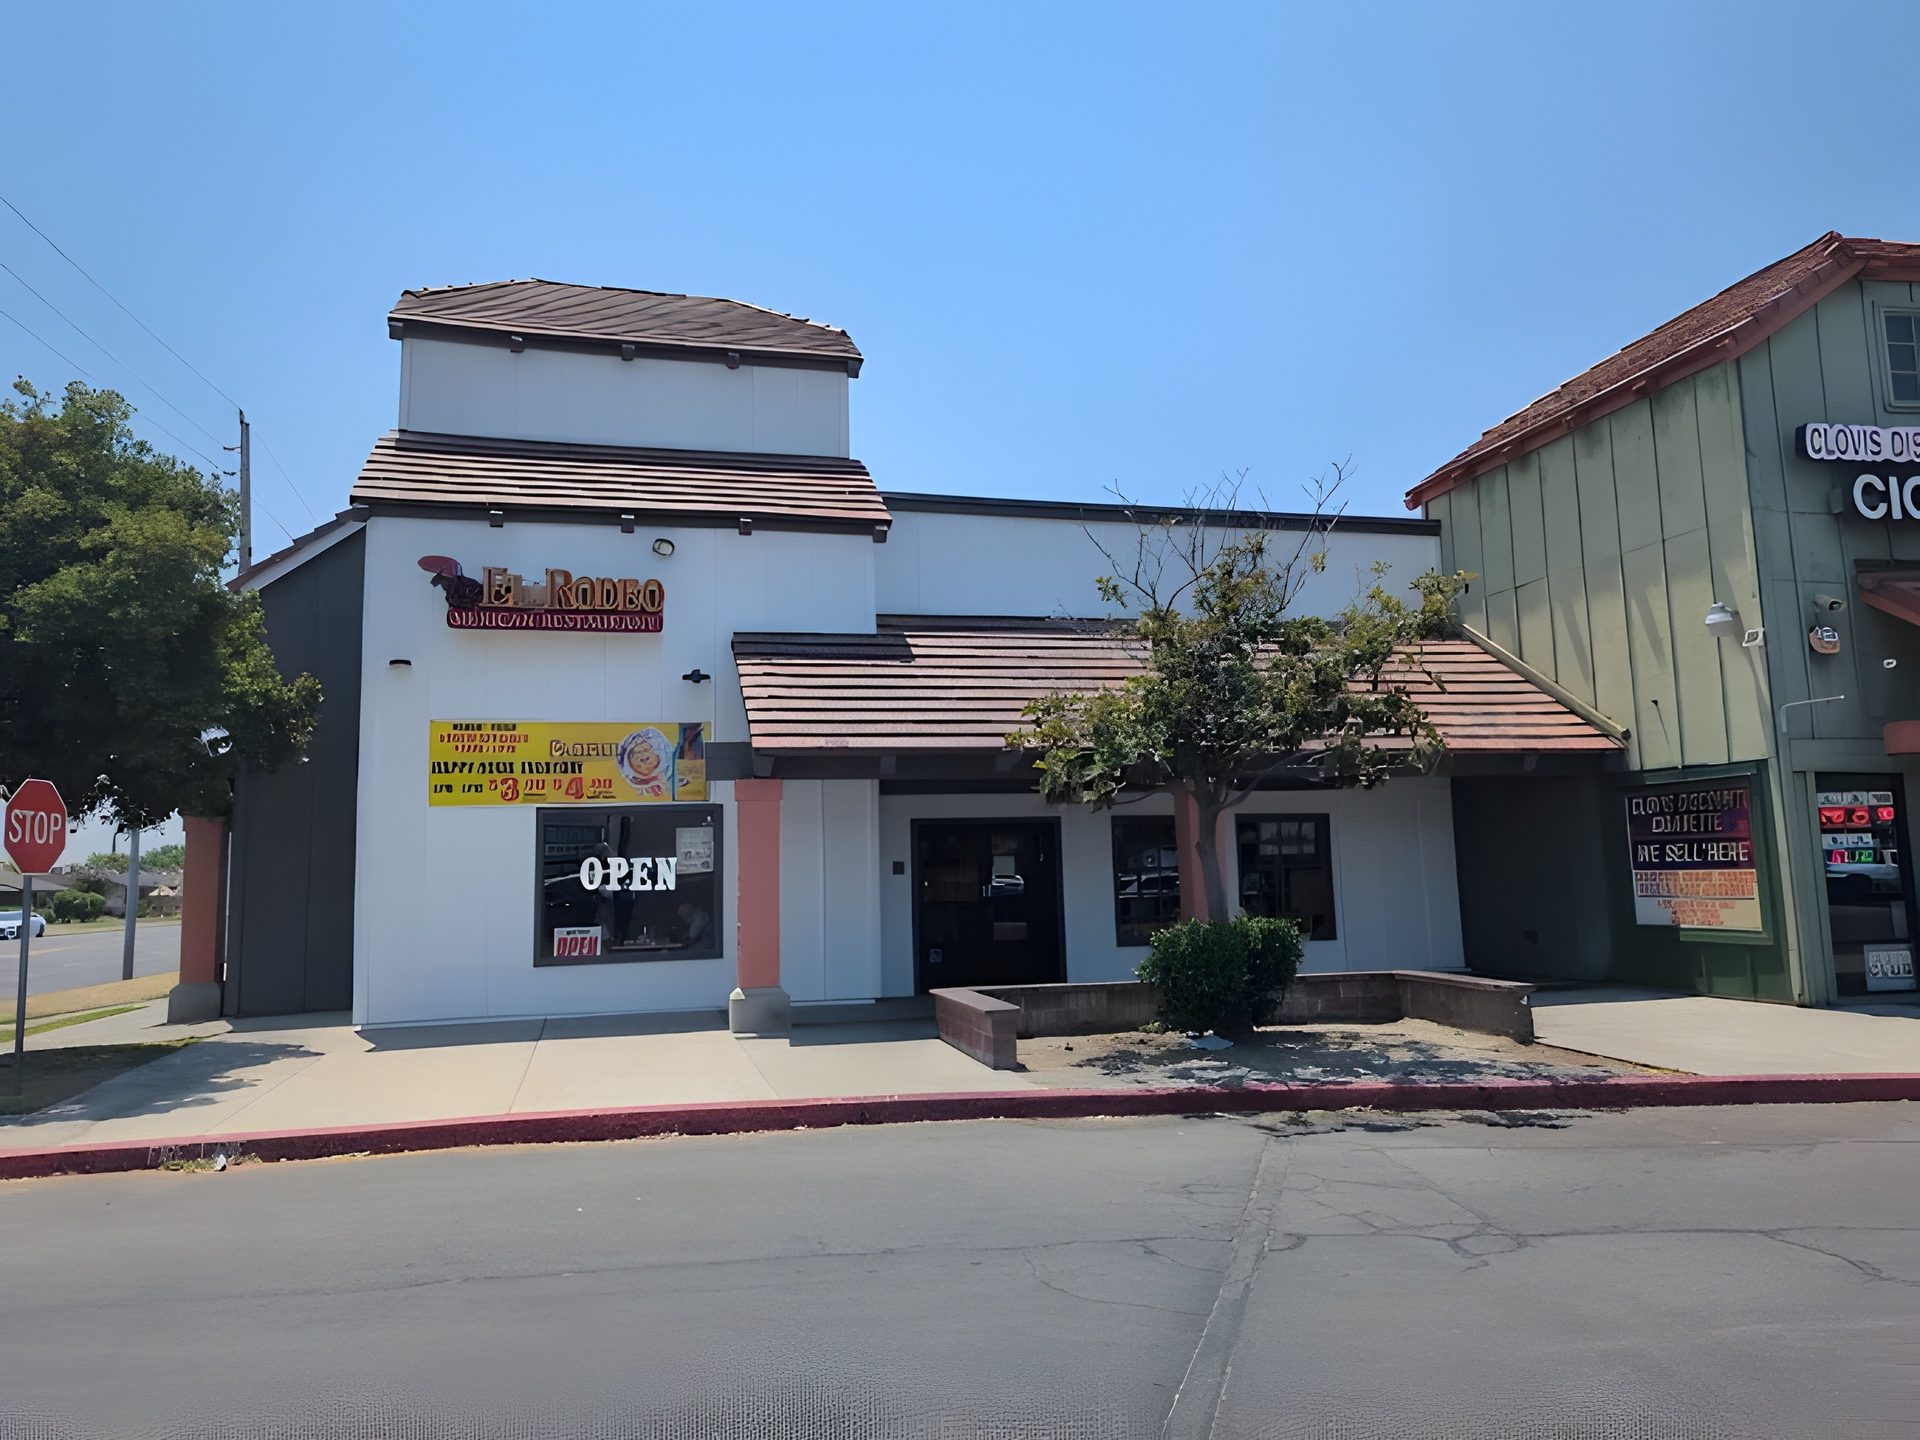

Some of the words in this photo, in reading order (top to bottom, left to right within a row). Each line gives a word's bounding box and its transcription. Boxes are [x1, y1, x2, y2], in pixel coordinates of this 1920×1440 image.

[1808, 425, 1883, 459] CLOVIS
[8, 809, 62, 844] STOP
[579, 856, 677, 891] OPEN
